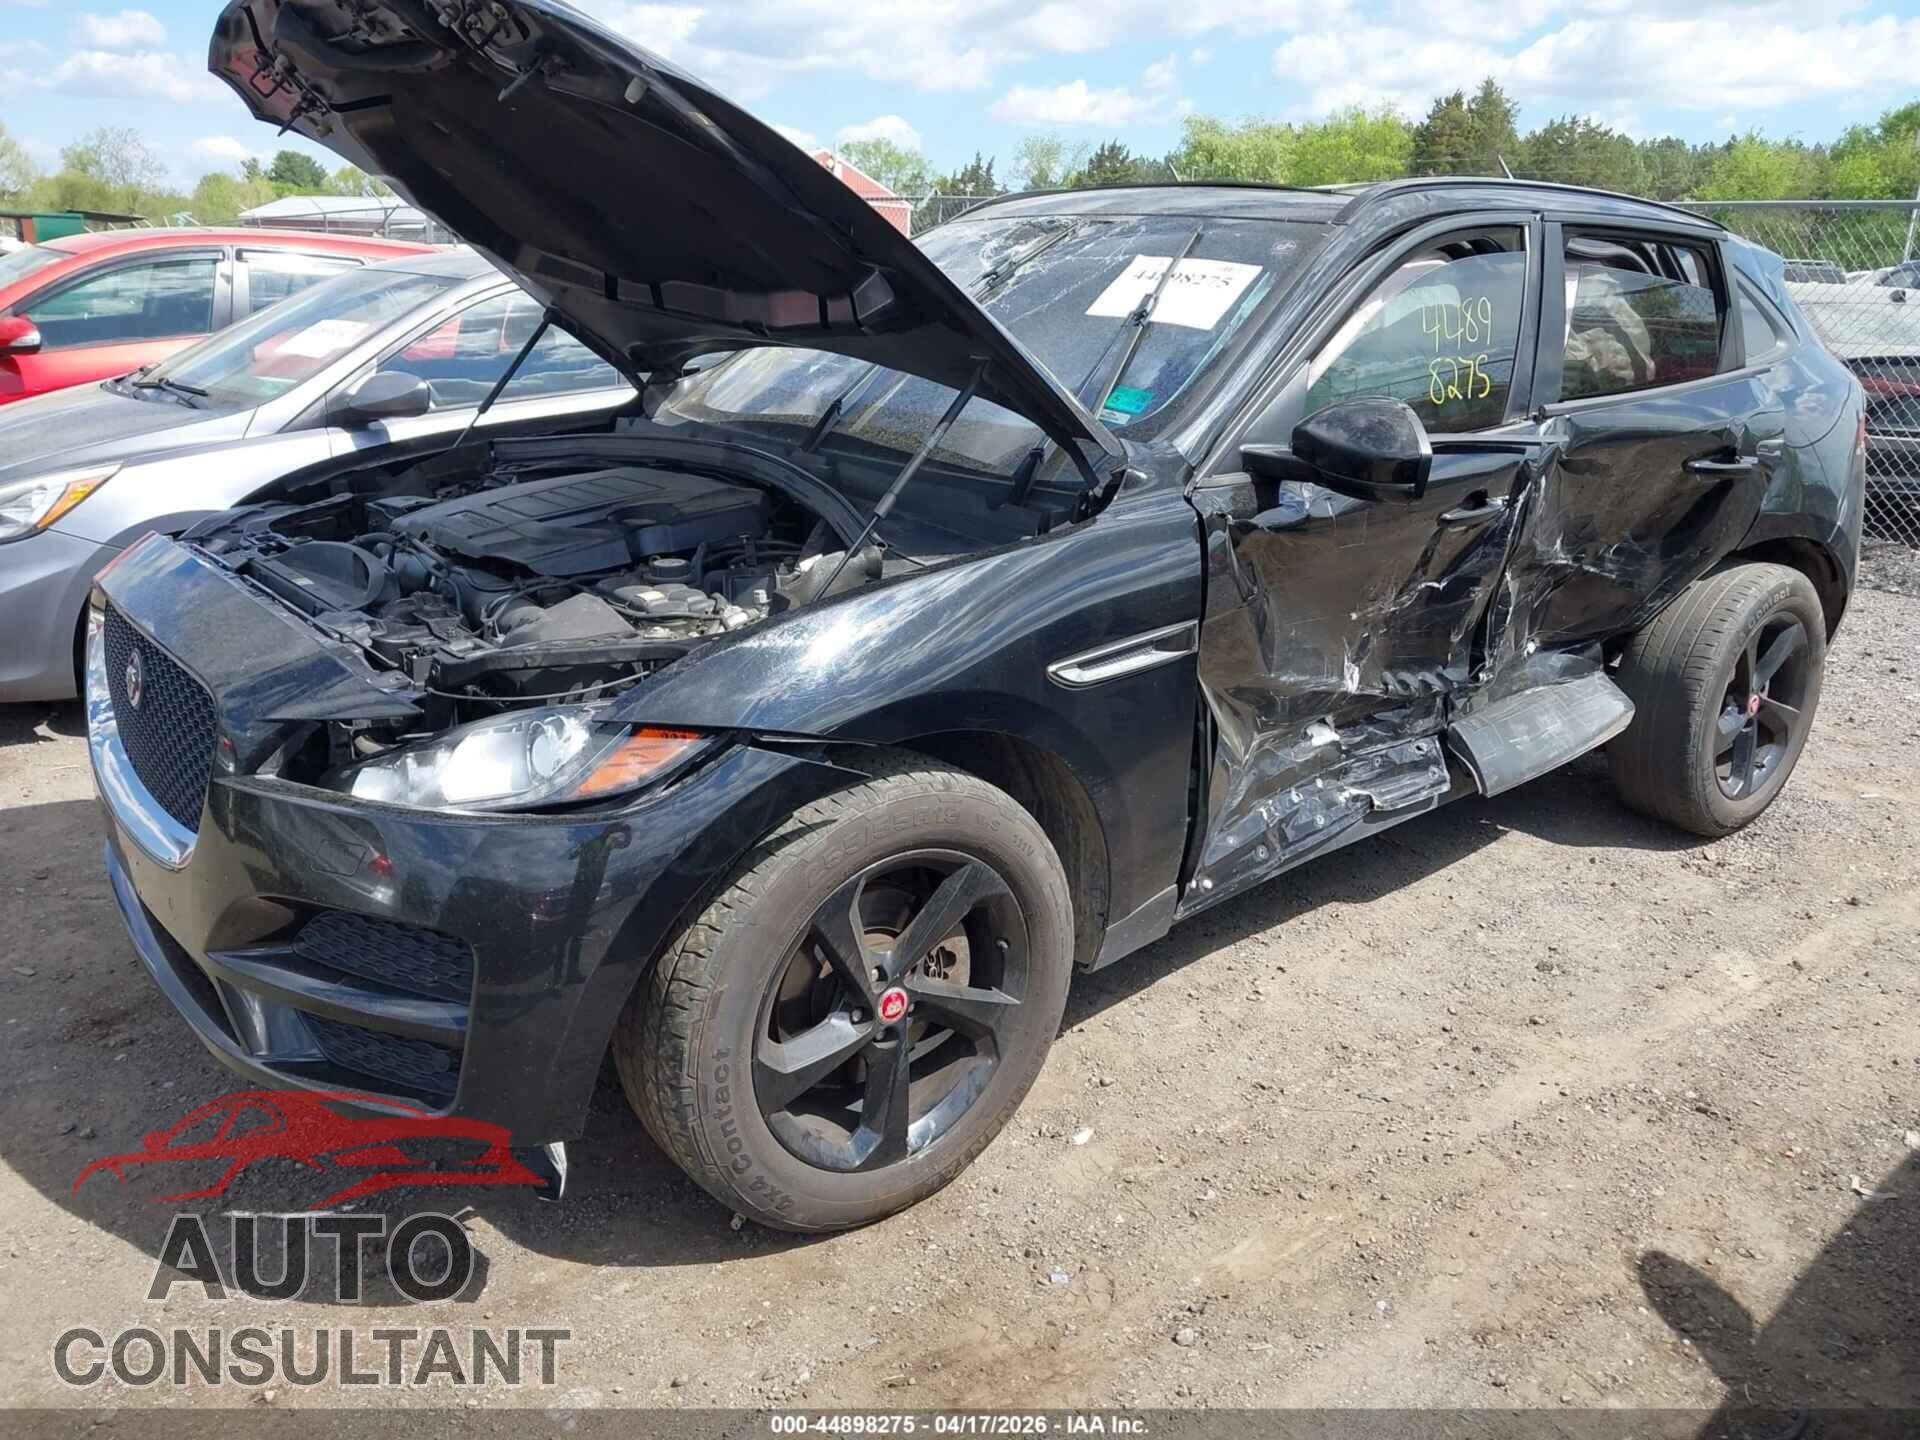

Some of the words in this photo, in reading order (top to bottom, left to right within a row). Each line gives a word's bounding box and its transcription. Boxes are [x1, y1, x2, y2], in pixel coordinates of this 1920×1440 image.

[1133, 269, 1233, 289] 4498275
[1422, 296, 1492, 352] 4489
[1429, 354, 1490, 404] 8275
[711, 1047, 752, 1175] Contact
